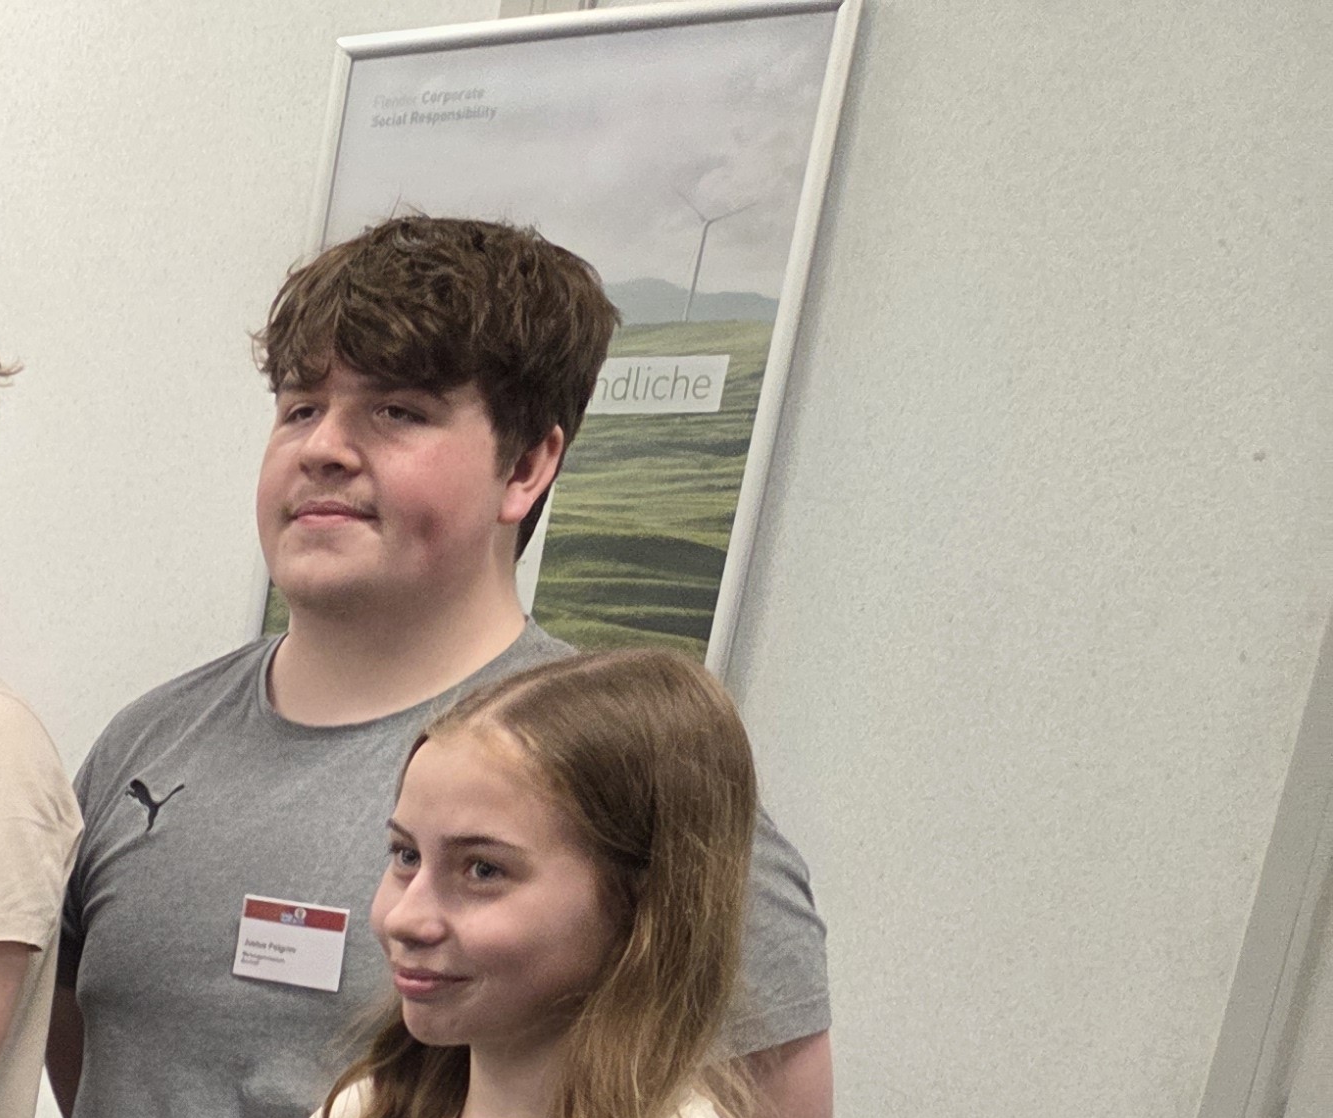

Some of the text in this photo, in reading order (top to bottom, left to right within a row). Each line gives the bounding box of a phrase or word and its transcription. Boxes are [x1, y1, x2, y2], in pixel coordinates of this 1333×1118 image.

[422, 88, 485, 106] Corporate
[371, 106, 498, 128] Social Responsibility
